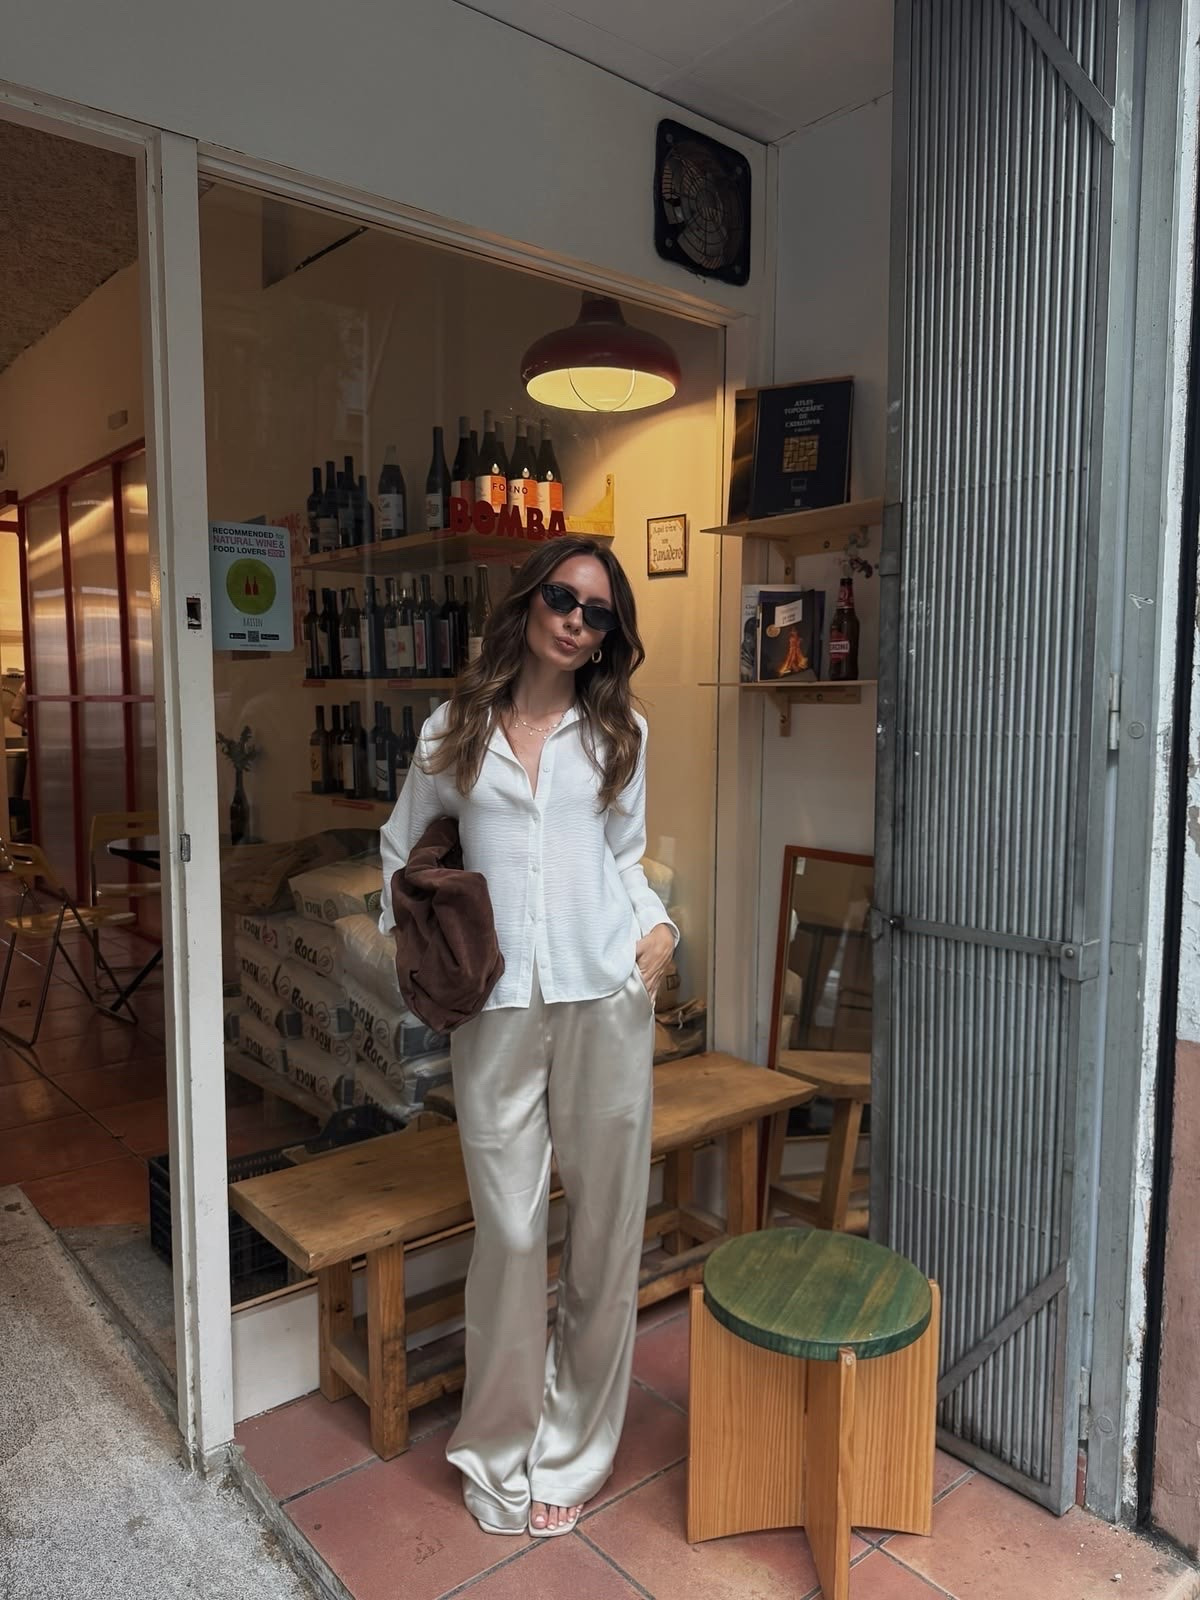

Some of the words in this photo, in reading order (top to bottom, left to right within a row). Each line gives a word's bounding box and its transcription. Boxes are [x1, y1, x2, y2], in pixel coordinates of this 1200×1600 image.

[212, 527, 274, 539] RECOMMENDED
[449, 497, 567, 541] BOMBA
[212, 535, 254, 546] NATURAL
[255, 538, 278, 549] WINE
[278, 540, 285, 549] &
[213, 545, 235, 553] FOOD
[237, 547, 267, 556] LOVERS
[294, 937, 318, 965] ROCA
[291, 987, 314, 1017] ROCA
[363, 1036, 388, 1075] ROCA
